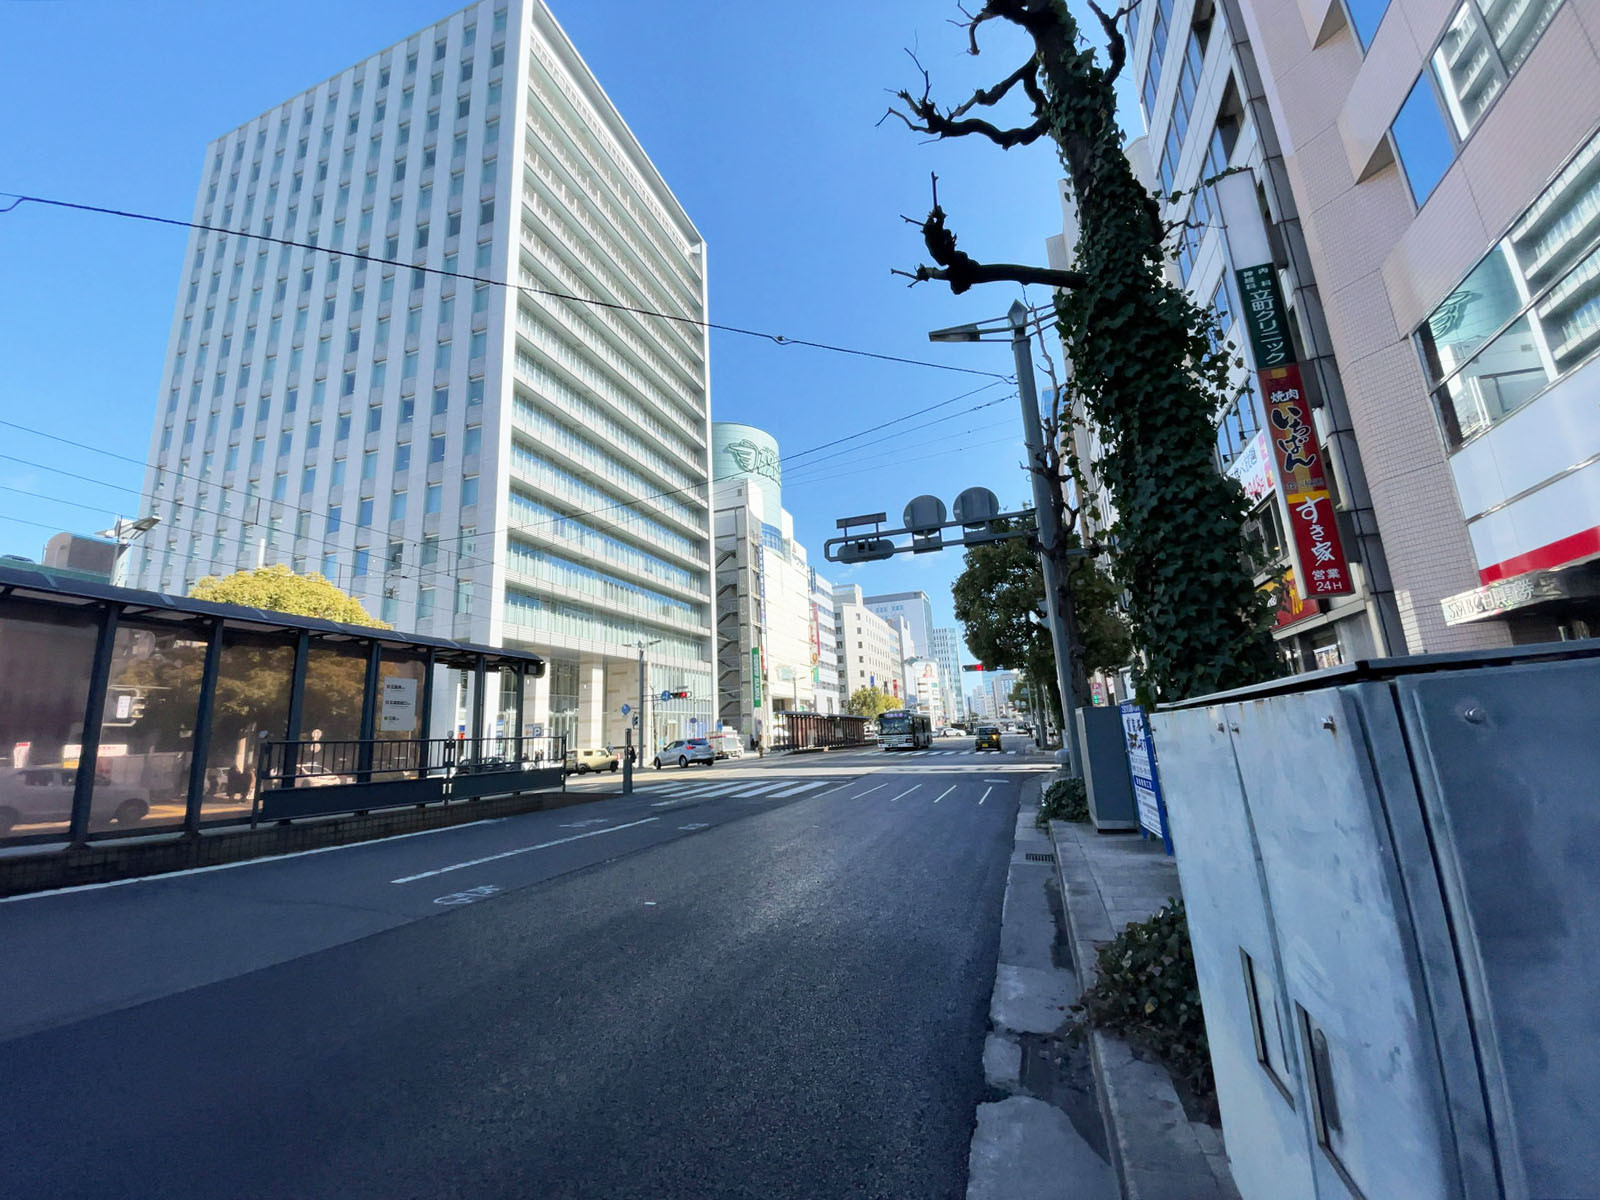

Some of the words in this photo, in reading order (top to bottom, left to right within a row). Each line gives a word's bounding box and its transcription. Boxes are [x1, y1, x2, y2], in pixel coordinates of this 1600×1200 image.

[1250, 289, 1285, 364] 立町クリニック
[1270, 388, 1299, 404] 焼肉
[1271, 406, 1317, 473] いちばん
[1296, 496, 1336, 567] すき家
[1312, 568, 1341, 581] 営業
[1316, 581, 1343, 592] 24H
